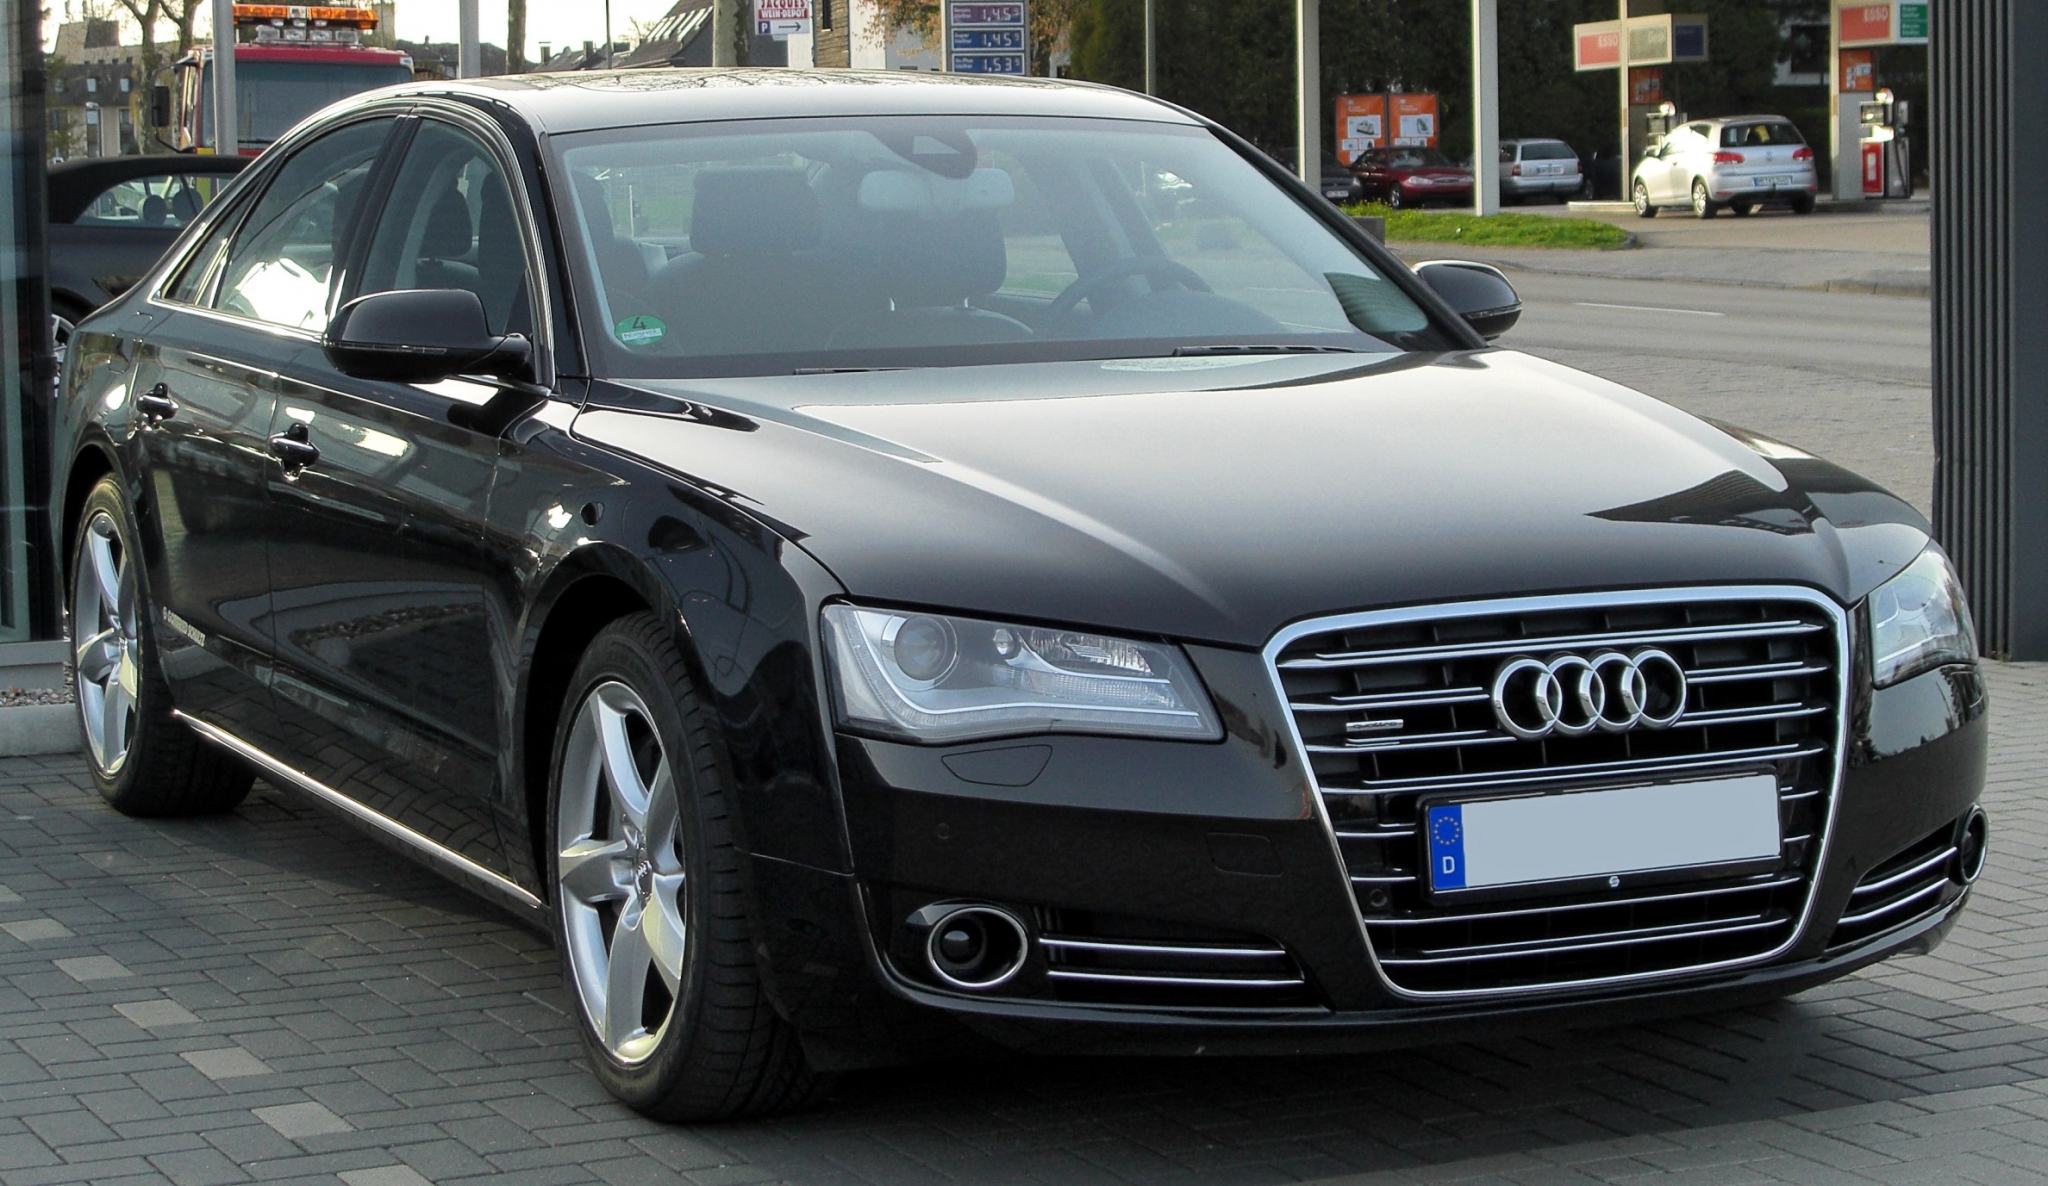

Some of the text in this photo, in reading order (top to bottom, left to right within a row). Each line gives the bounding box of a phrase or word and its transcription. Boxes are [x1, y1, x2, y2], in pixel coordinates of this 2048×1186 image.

[761, 0, 805, 8] JACQUES
[761, 9, 805, 18] WEIN-DEPOT
[761, 22, 768, 32] P
[632, 316, 646, 329] 4
[1442, 856, 1456, 874] D
